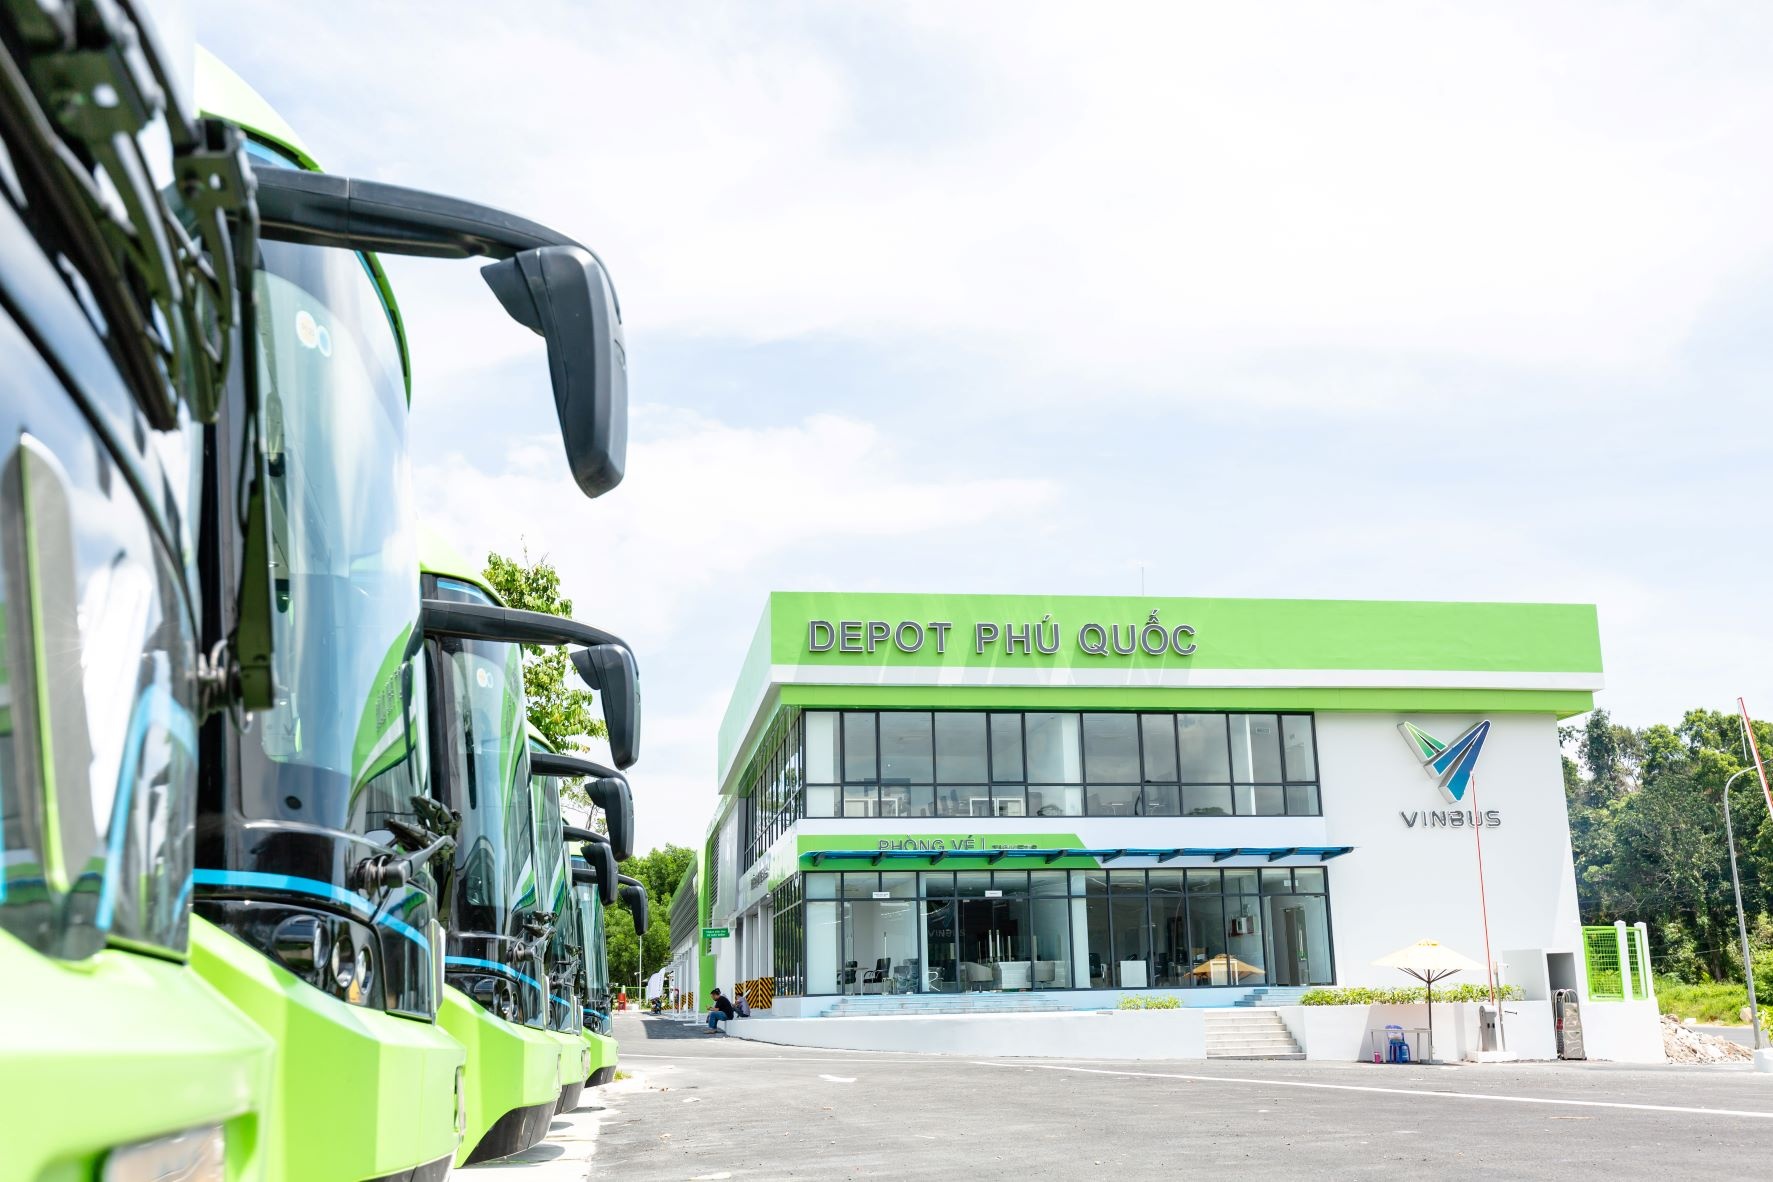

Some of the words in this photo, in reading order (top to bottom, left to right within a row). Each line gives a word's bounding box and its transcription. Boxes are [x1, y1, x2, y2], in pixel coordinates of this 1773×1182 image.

[807, 619, 953, 653] DEPOT
[974, 613, 1062, 655] PHÚ
[1077, 608, 1198, 657] QUỐC
[1399, 809, 1502, 828] VINBUS
[878, 834, 945, 851] PHÒNG
[927, 928, 967, 938] VINBS
